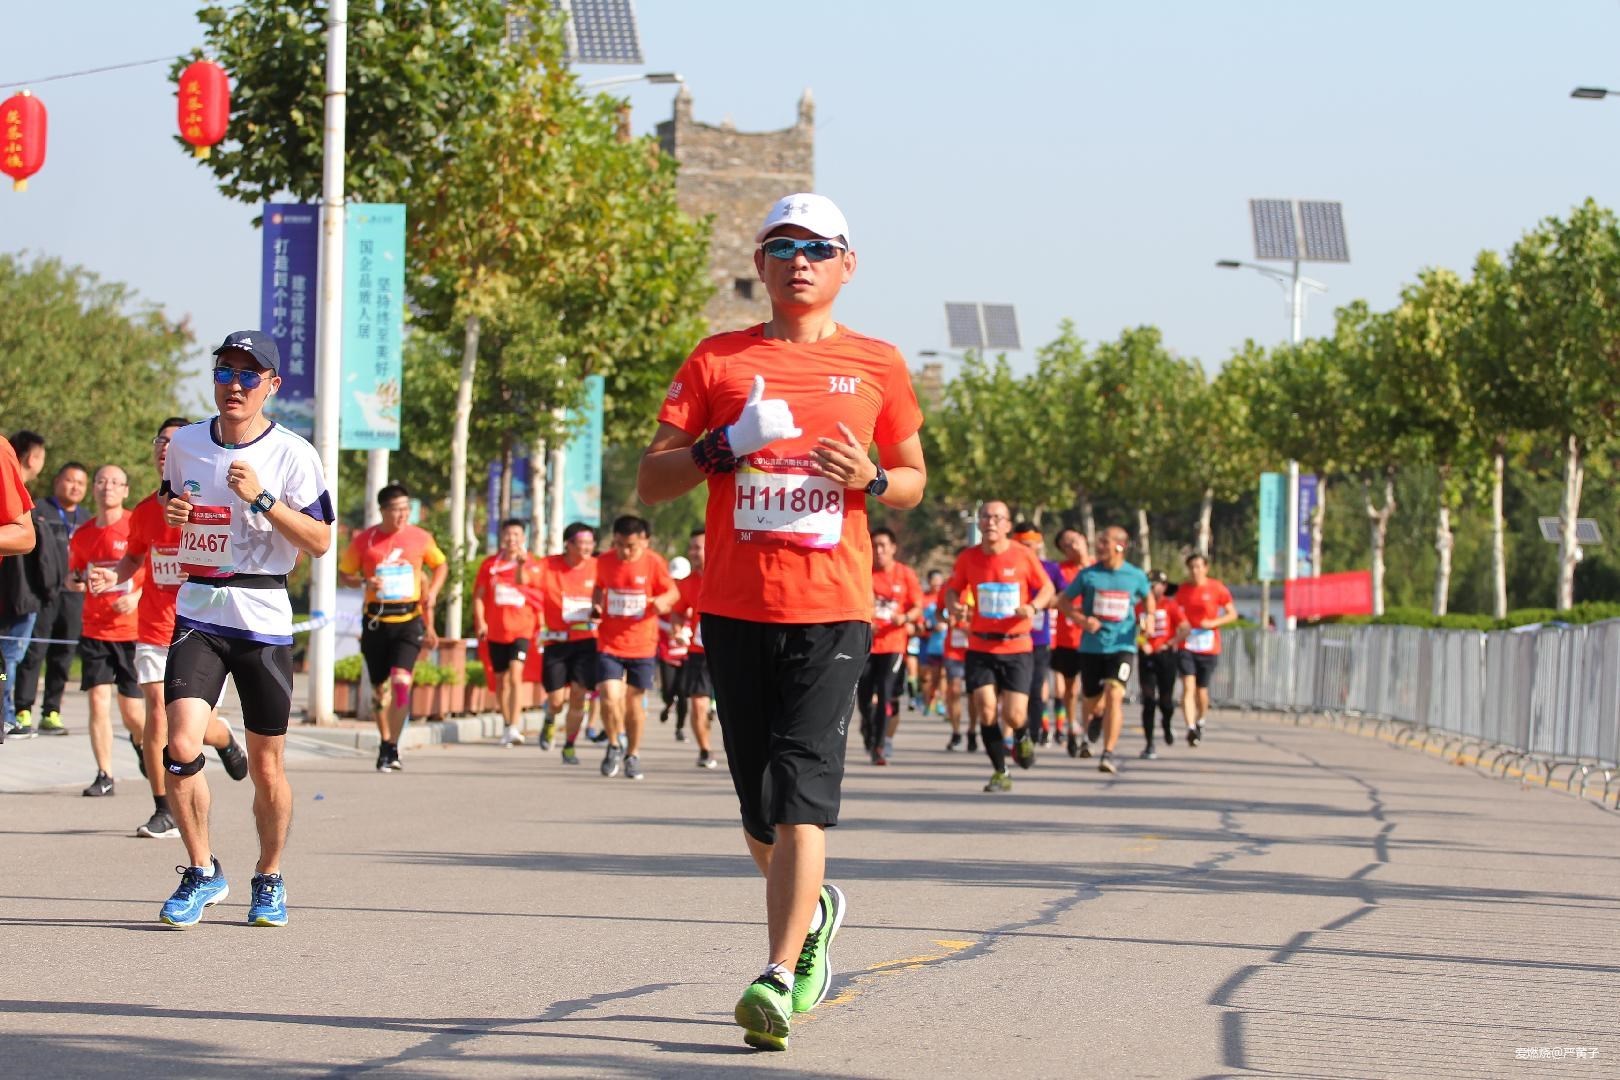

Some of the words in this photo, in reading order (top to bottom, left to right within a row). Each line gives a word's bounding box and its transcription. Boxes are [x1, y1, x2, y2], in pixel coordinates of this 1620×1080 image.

[273, 239, 289, 337] 打造四个中心
[737, 485, 840, 515] H11808
